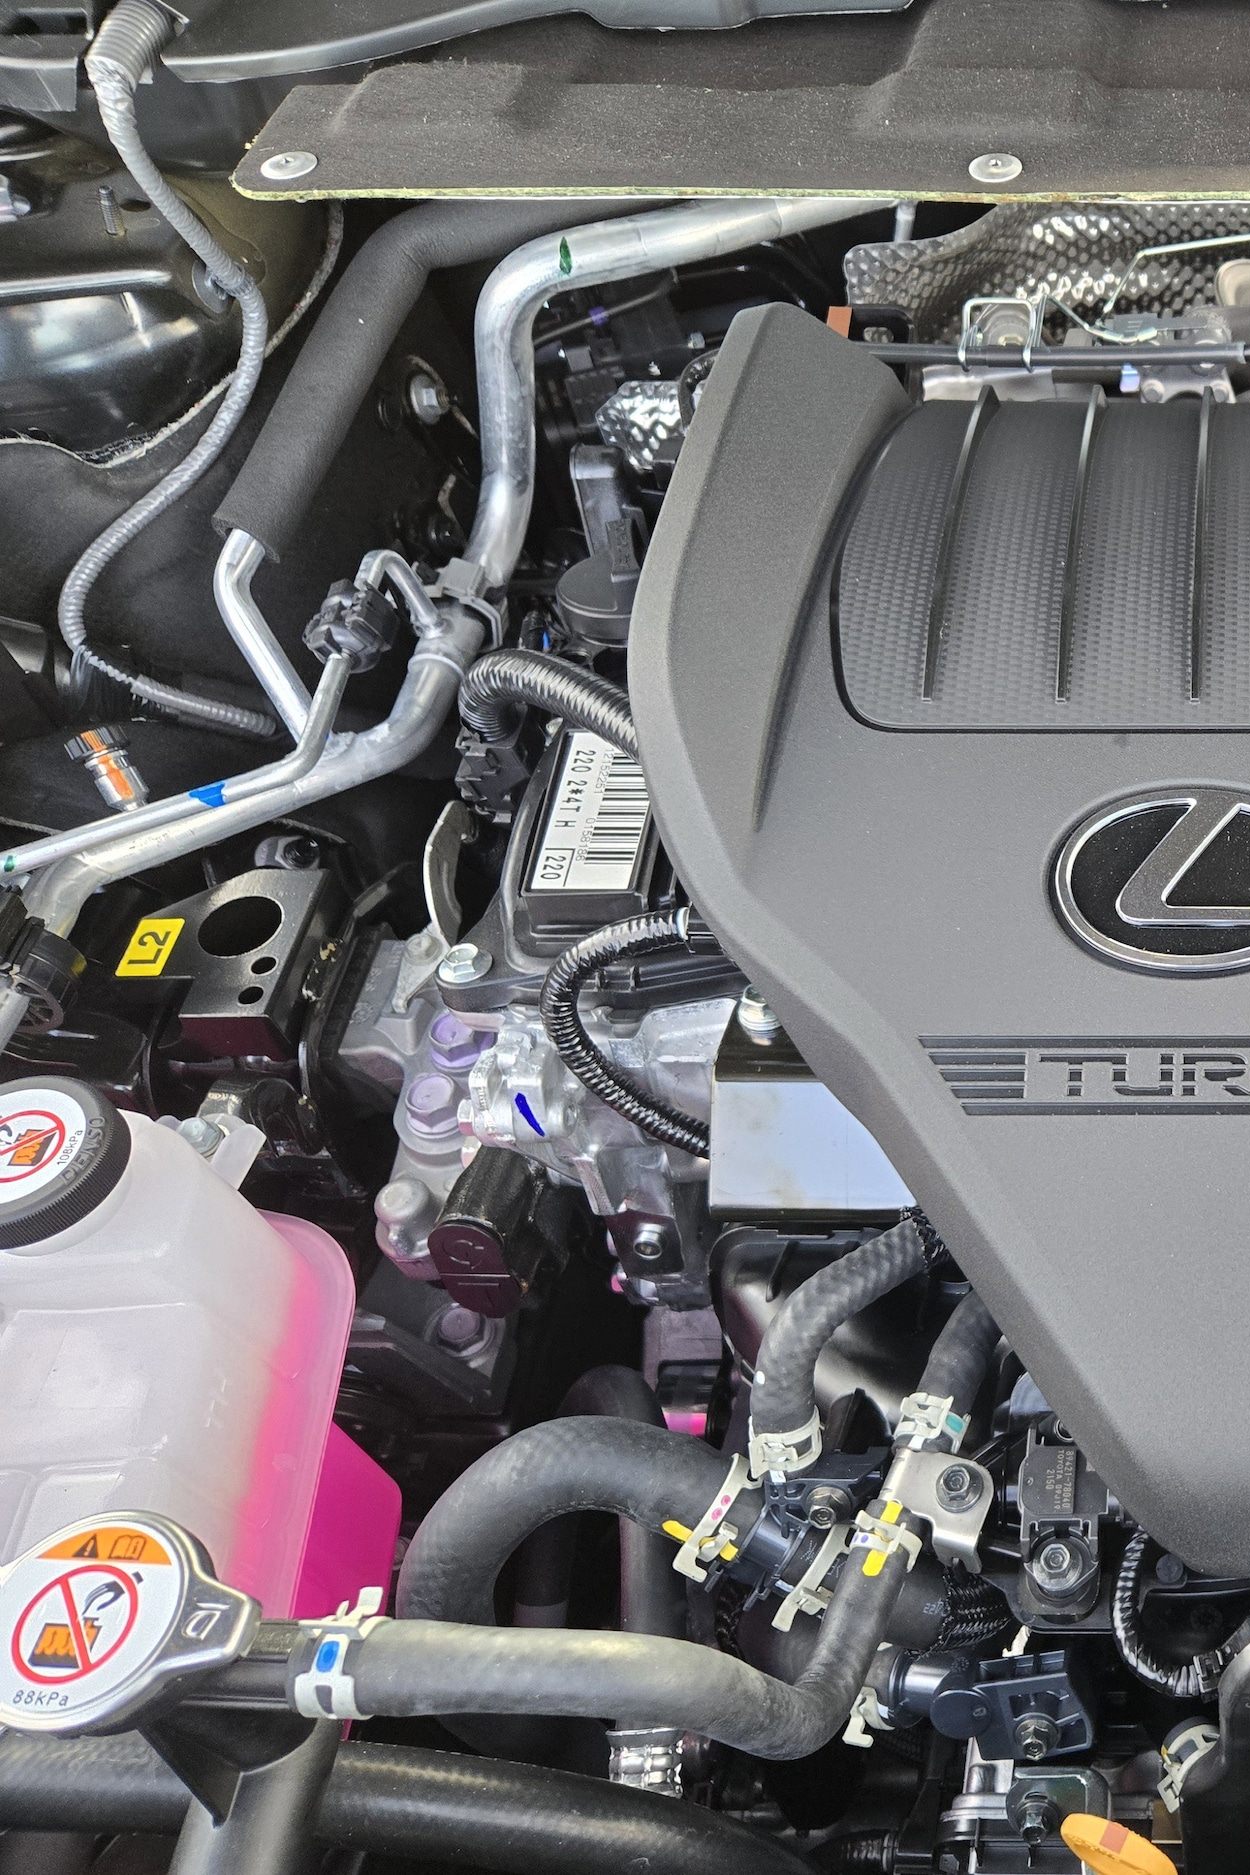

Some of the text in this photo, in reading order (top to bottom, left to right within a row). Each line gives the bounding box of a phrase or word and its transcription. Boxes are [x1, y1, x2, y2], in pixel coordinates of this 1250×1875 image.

[571, 749, 597, 773] 220
[554, 819, 577, 828] H
[575, 817, 597, 862] 0158186
[540, 855, 567, 880] 220
[127, 930, 172, 965] L2
[61, 1116, 106, 1184] DENSO
[1056, 1449, 1065, 1480] TOYOTA
[1062, 1450, 1075, 1508] 89421-78040
[12, 1689, 69, 1706] 88kPa
